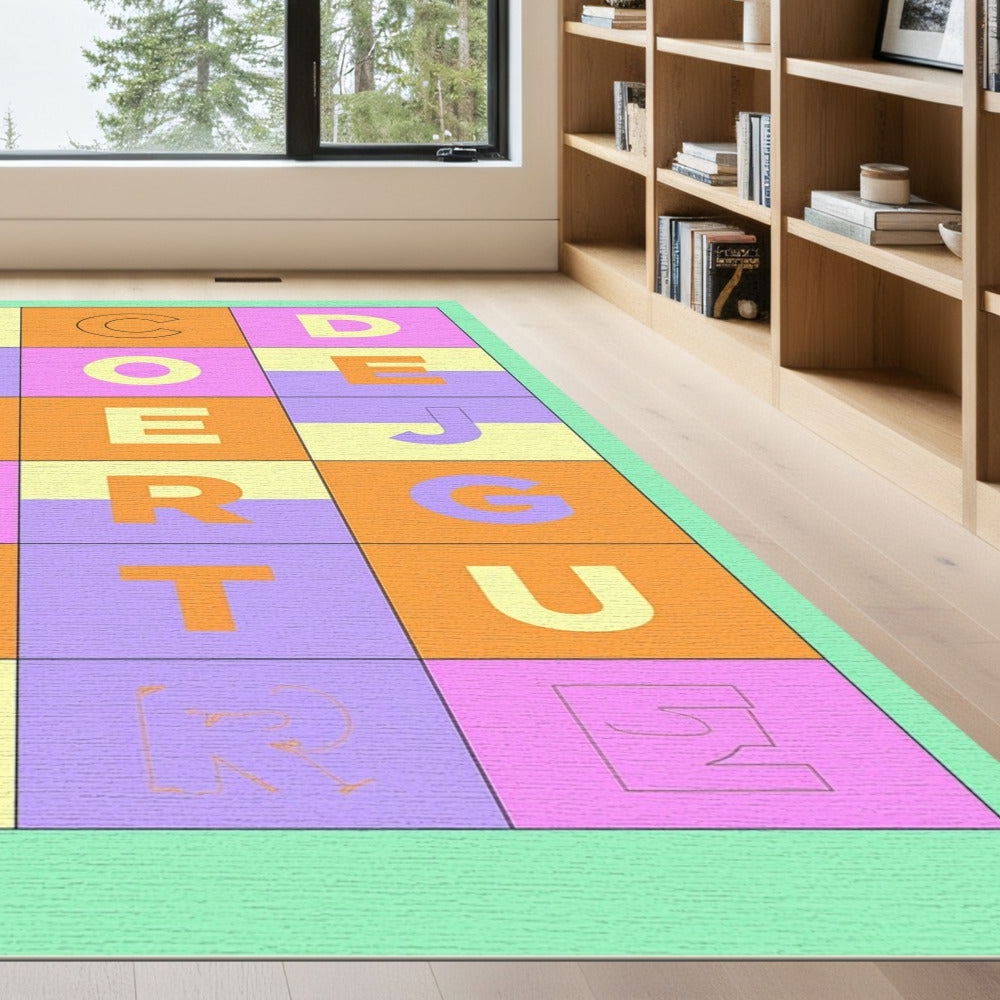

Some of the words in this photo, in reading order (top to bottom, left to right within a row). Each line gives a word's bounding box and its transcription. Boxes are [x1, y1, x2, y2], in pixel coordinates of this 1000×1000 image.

[75, 313, 182, 338] C
[295, 314, 401, 338] D
[83, 356, 202, 385] O
[329, 356, 447, 385] E
[104, 407, 221, 444] E
[388, 407, 482, 445] J
[106, 475, 254, 523] R
[409, 474, 575, 524] G
[119, 565, 276, 631] T
[466, 565, 654, 632] U
